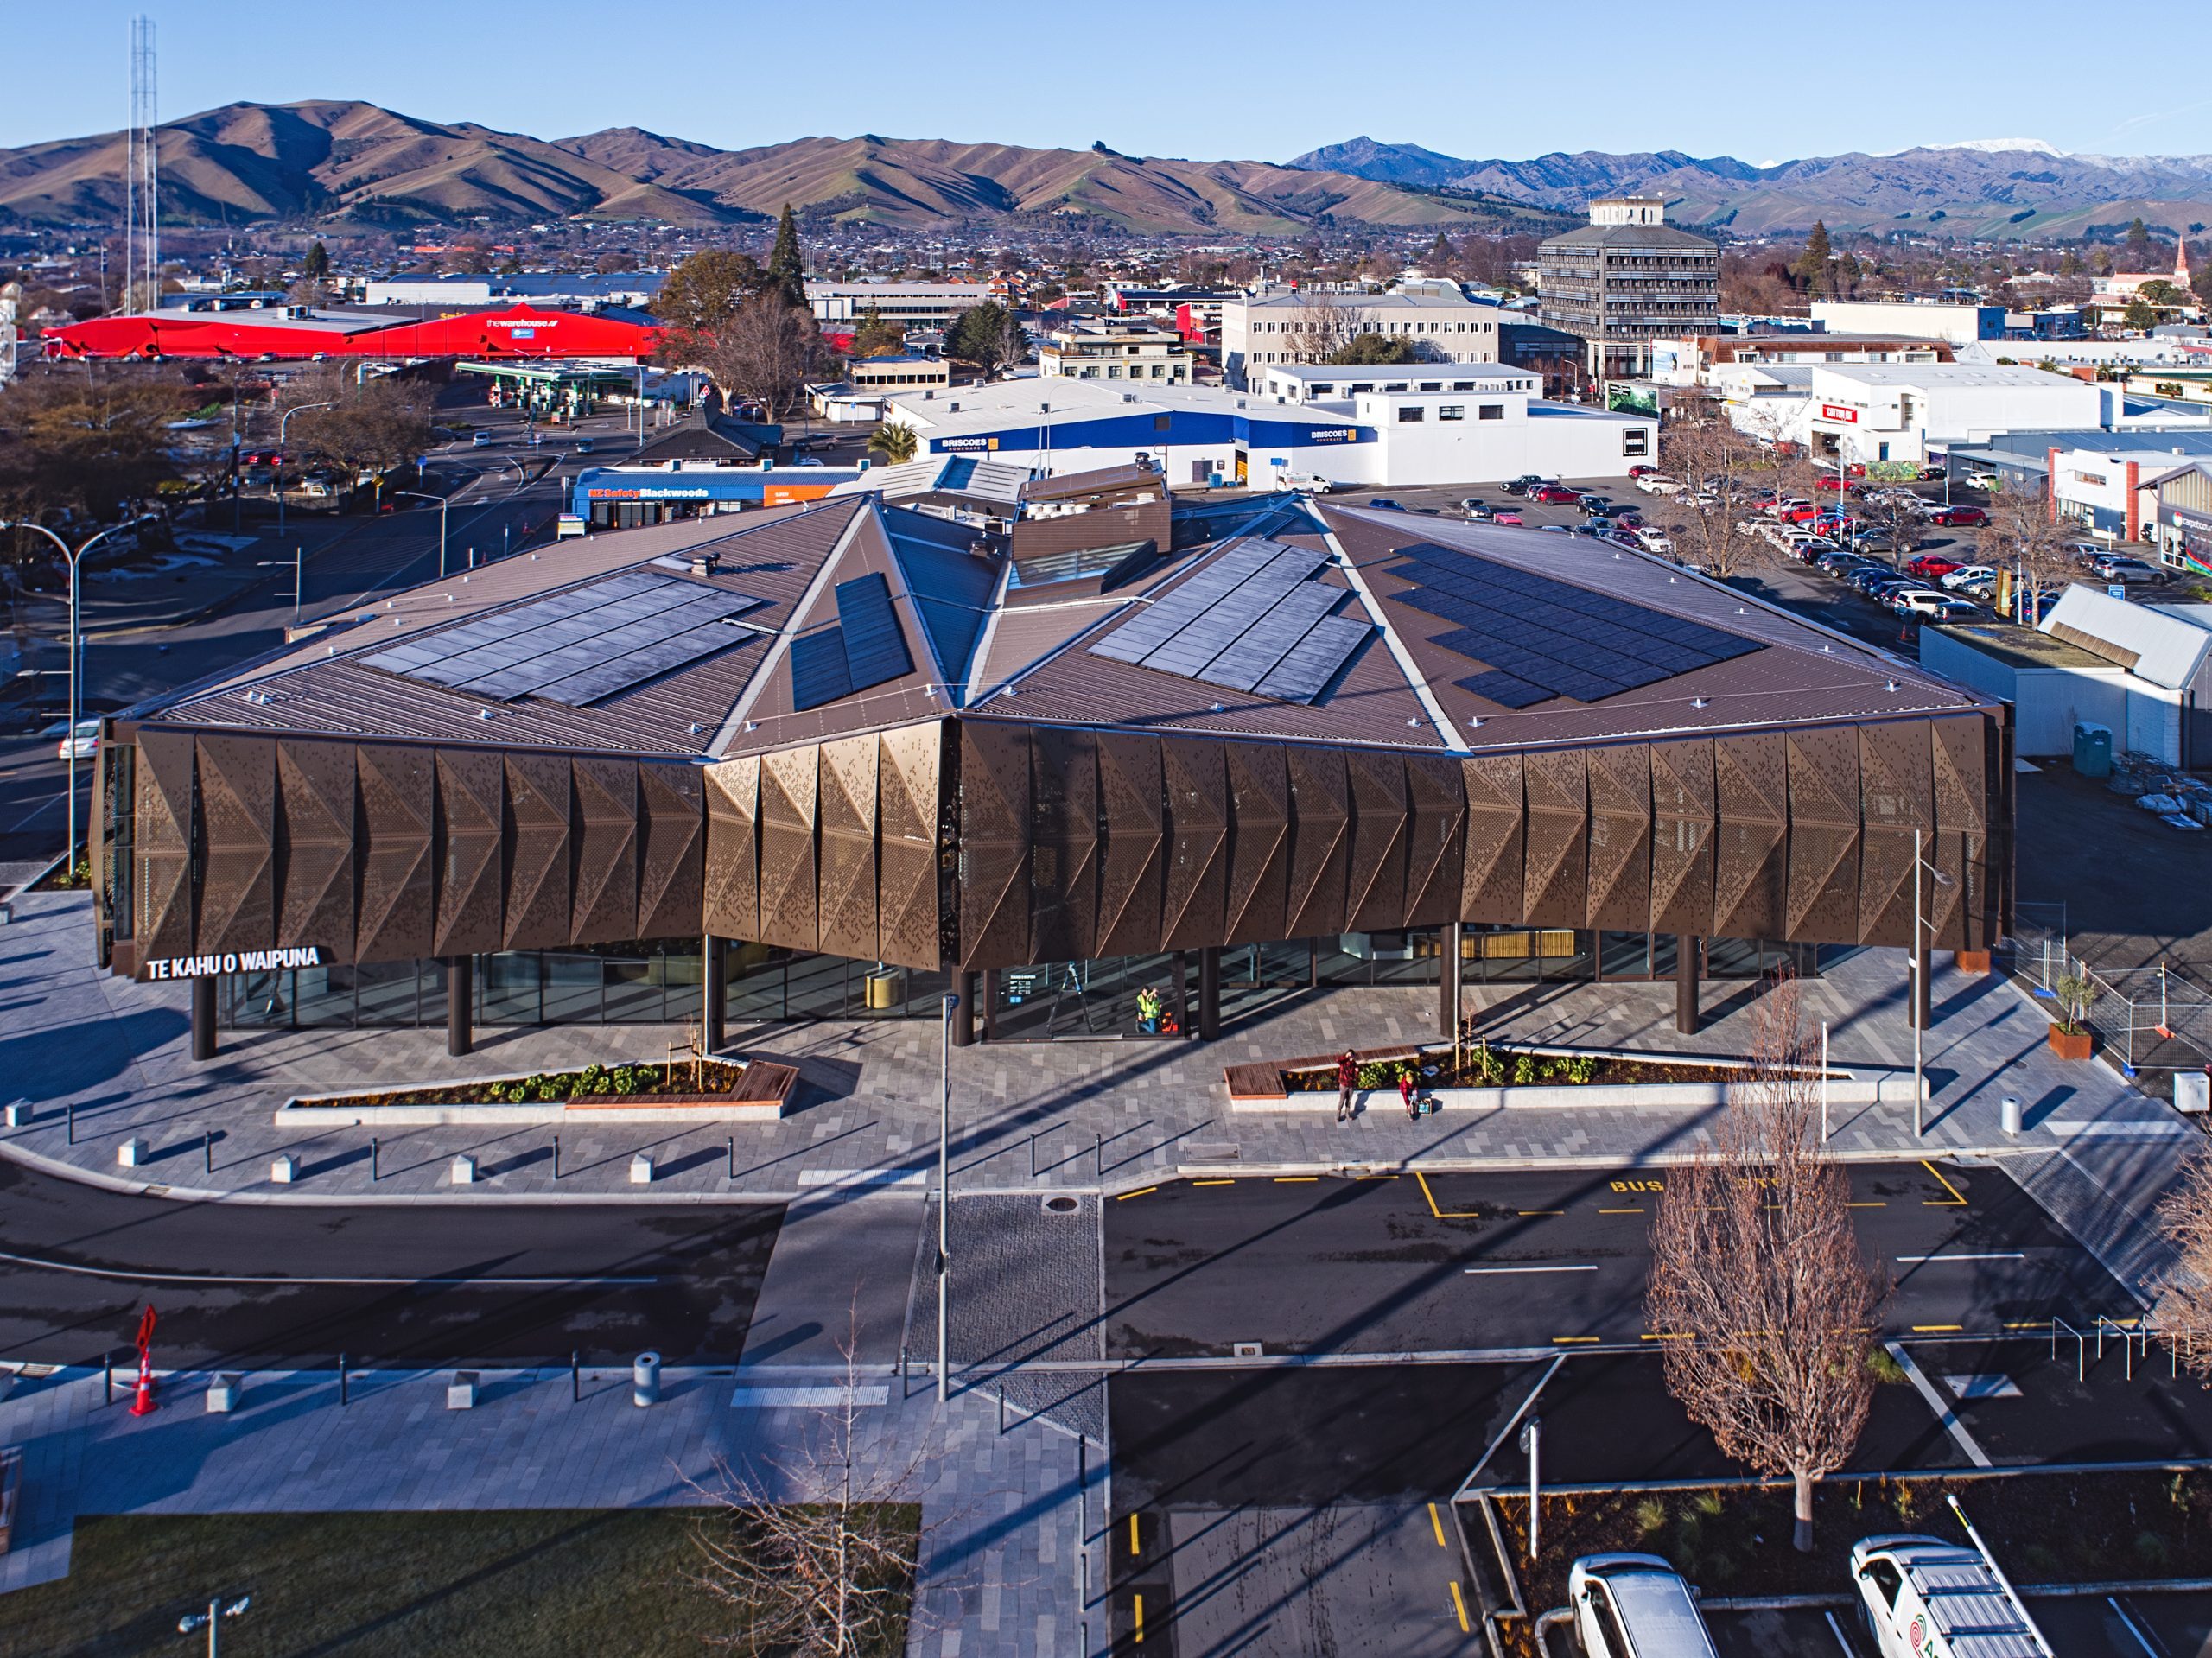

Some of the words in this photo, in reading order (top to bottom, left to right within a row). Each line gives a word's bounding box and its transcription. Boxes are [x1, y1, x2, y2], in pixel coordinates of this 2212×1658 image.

[942, 438, 987, 447] BRISCOES
[147, 959, 170, 980] TE
[171, 955, 221, 977] KAHU
[223, 953, 237, 973] O
[239, 947, 319, 972] WAIPUNA
[1610, 1181, 1664, 1192] BUS
